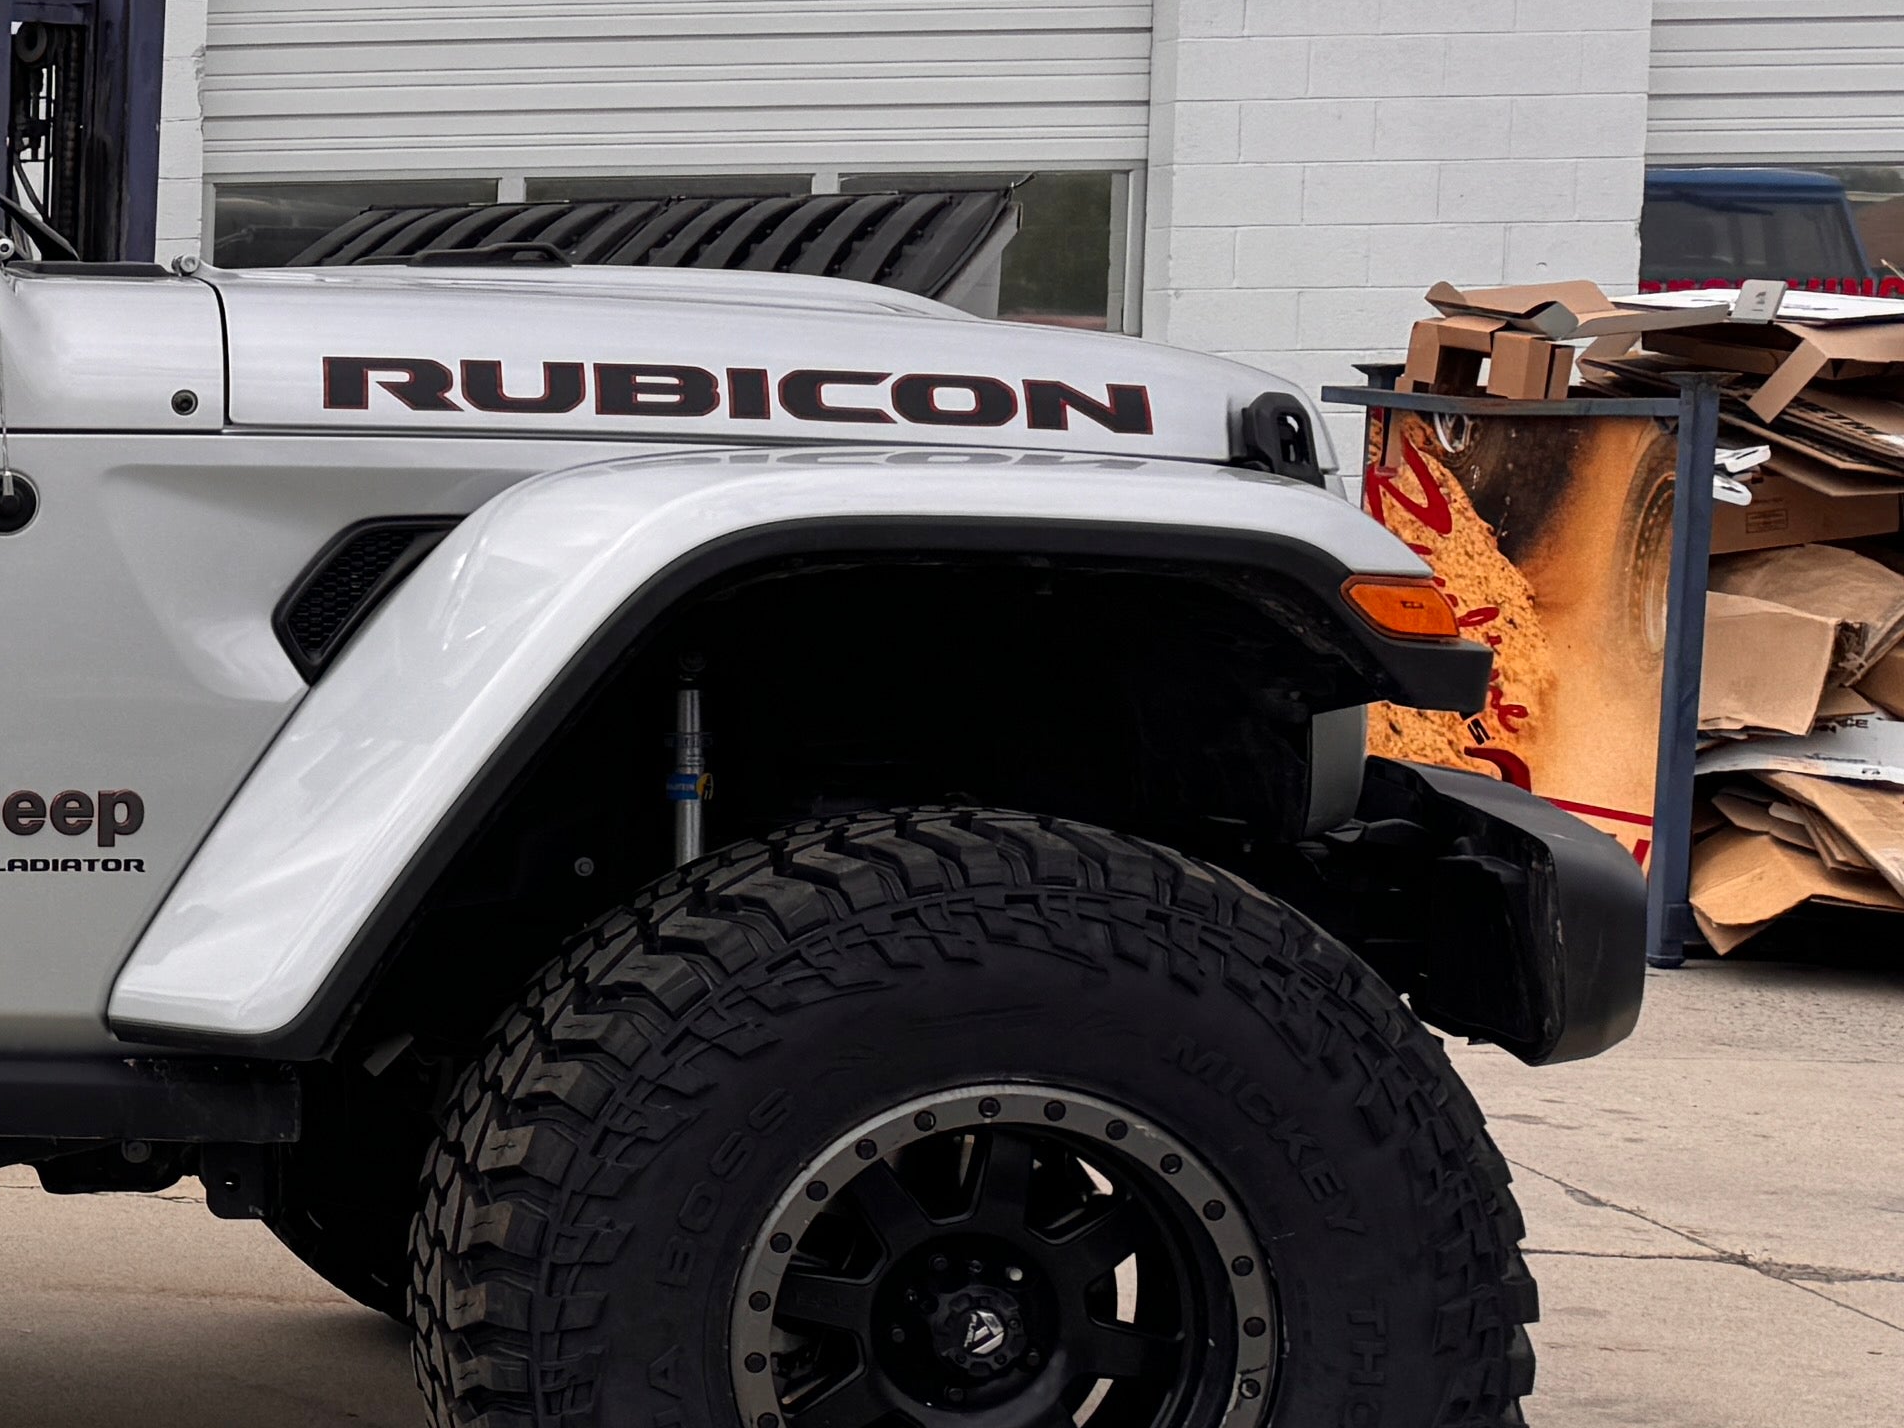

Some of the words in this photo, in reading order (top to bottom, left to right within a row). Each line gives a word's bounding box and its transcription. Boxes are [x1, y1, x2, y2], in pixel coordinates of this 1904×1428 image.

[321, 355, 1155, 437] RUBICON
[658, 1086, 795, 1290] BOSS
[1162, 1033, 1370, 1236] MICKEY
